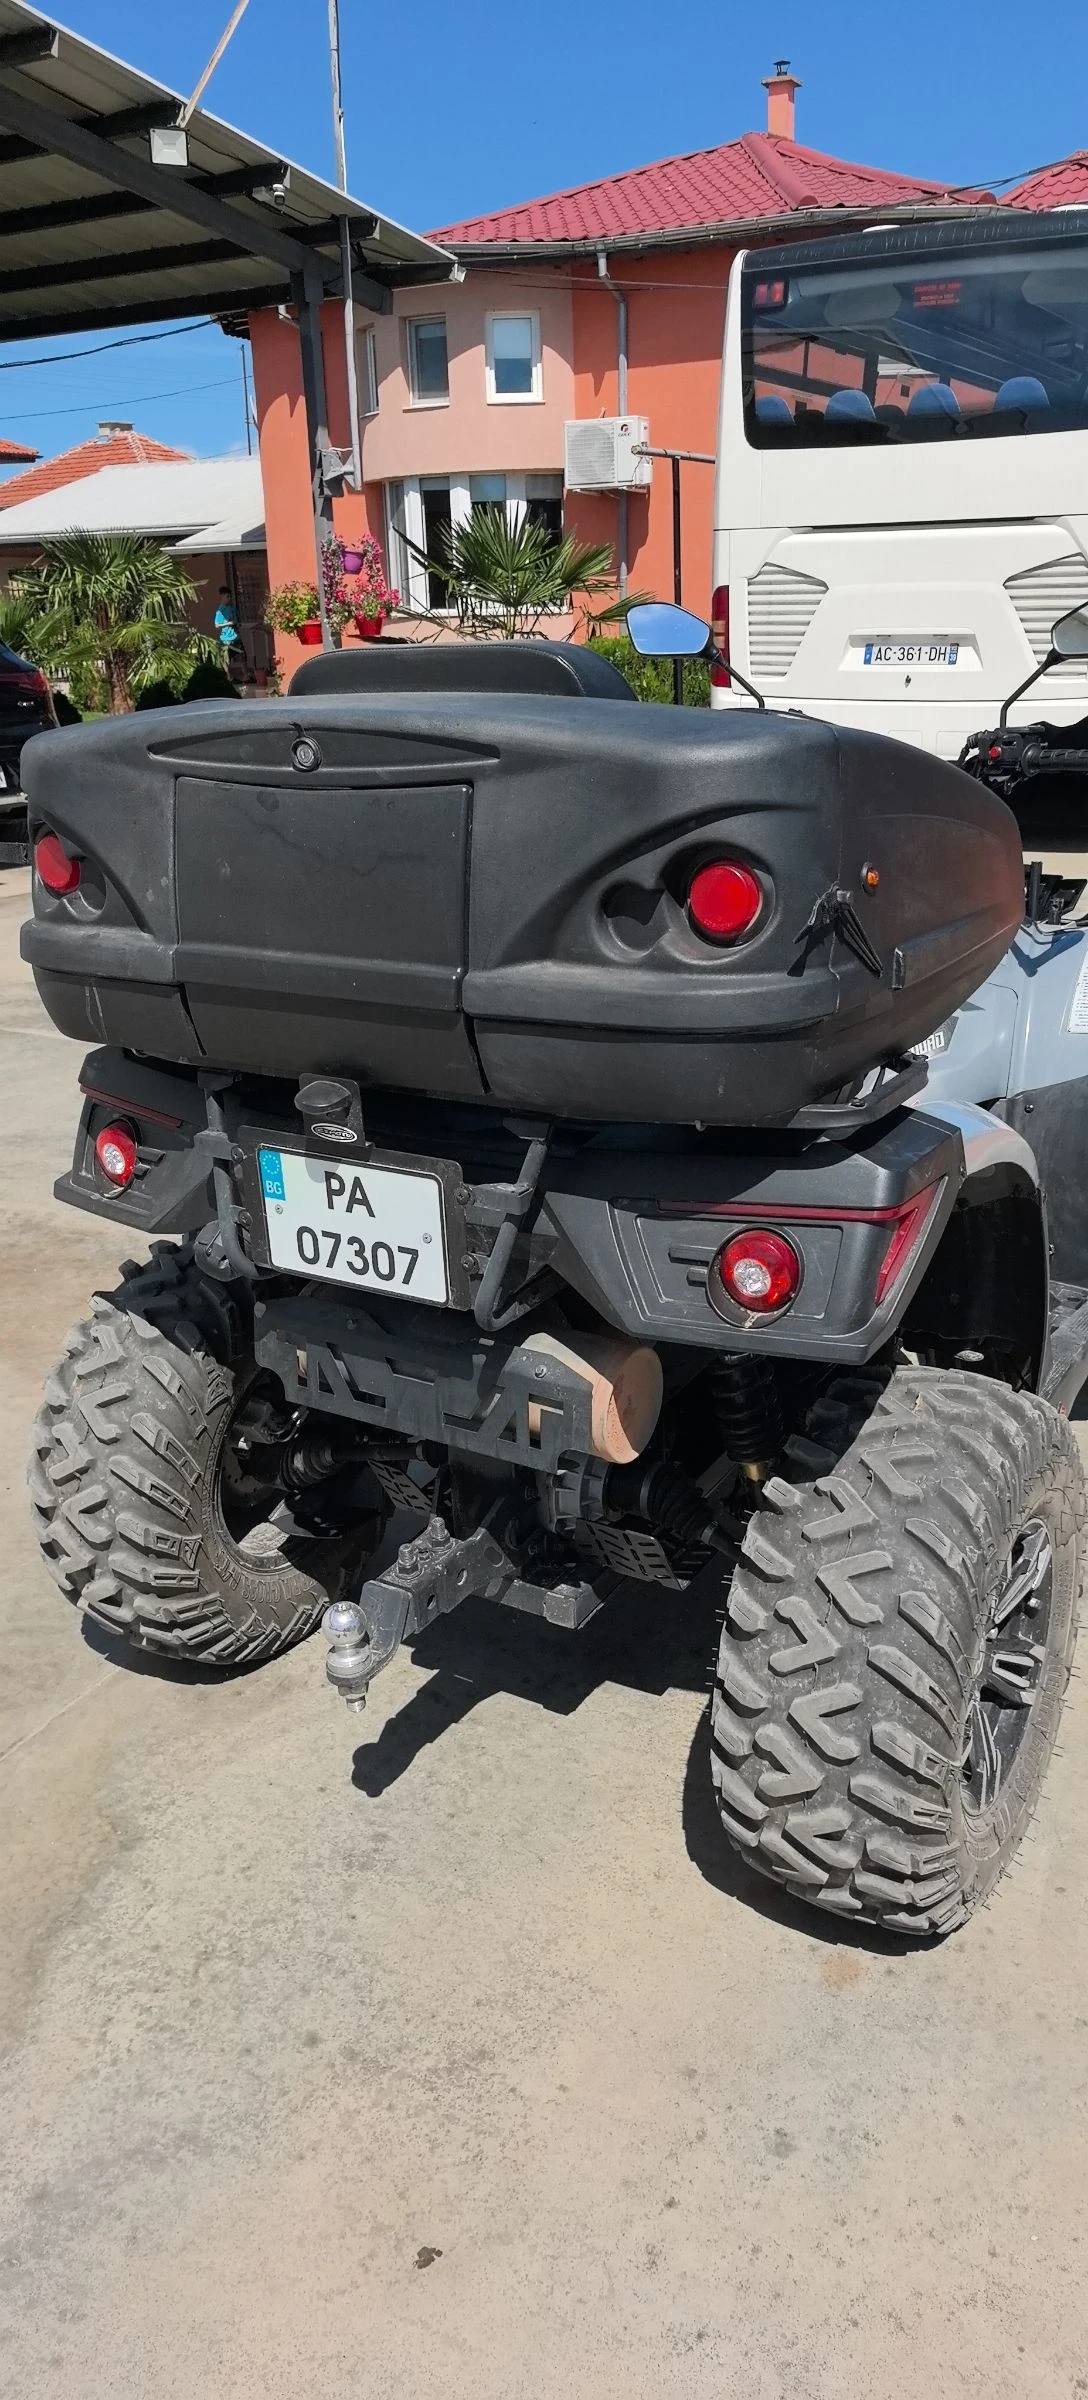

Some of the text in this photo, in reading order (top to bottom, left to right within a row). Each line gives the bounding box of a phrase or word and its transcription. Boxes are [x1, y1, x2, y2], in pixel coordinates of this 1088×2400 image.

[265, 1180, 282, 1195] BG
[325, 1171, 376, 1218] PA
[296, 1225, 419, 1285] 07307
